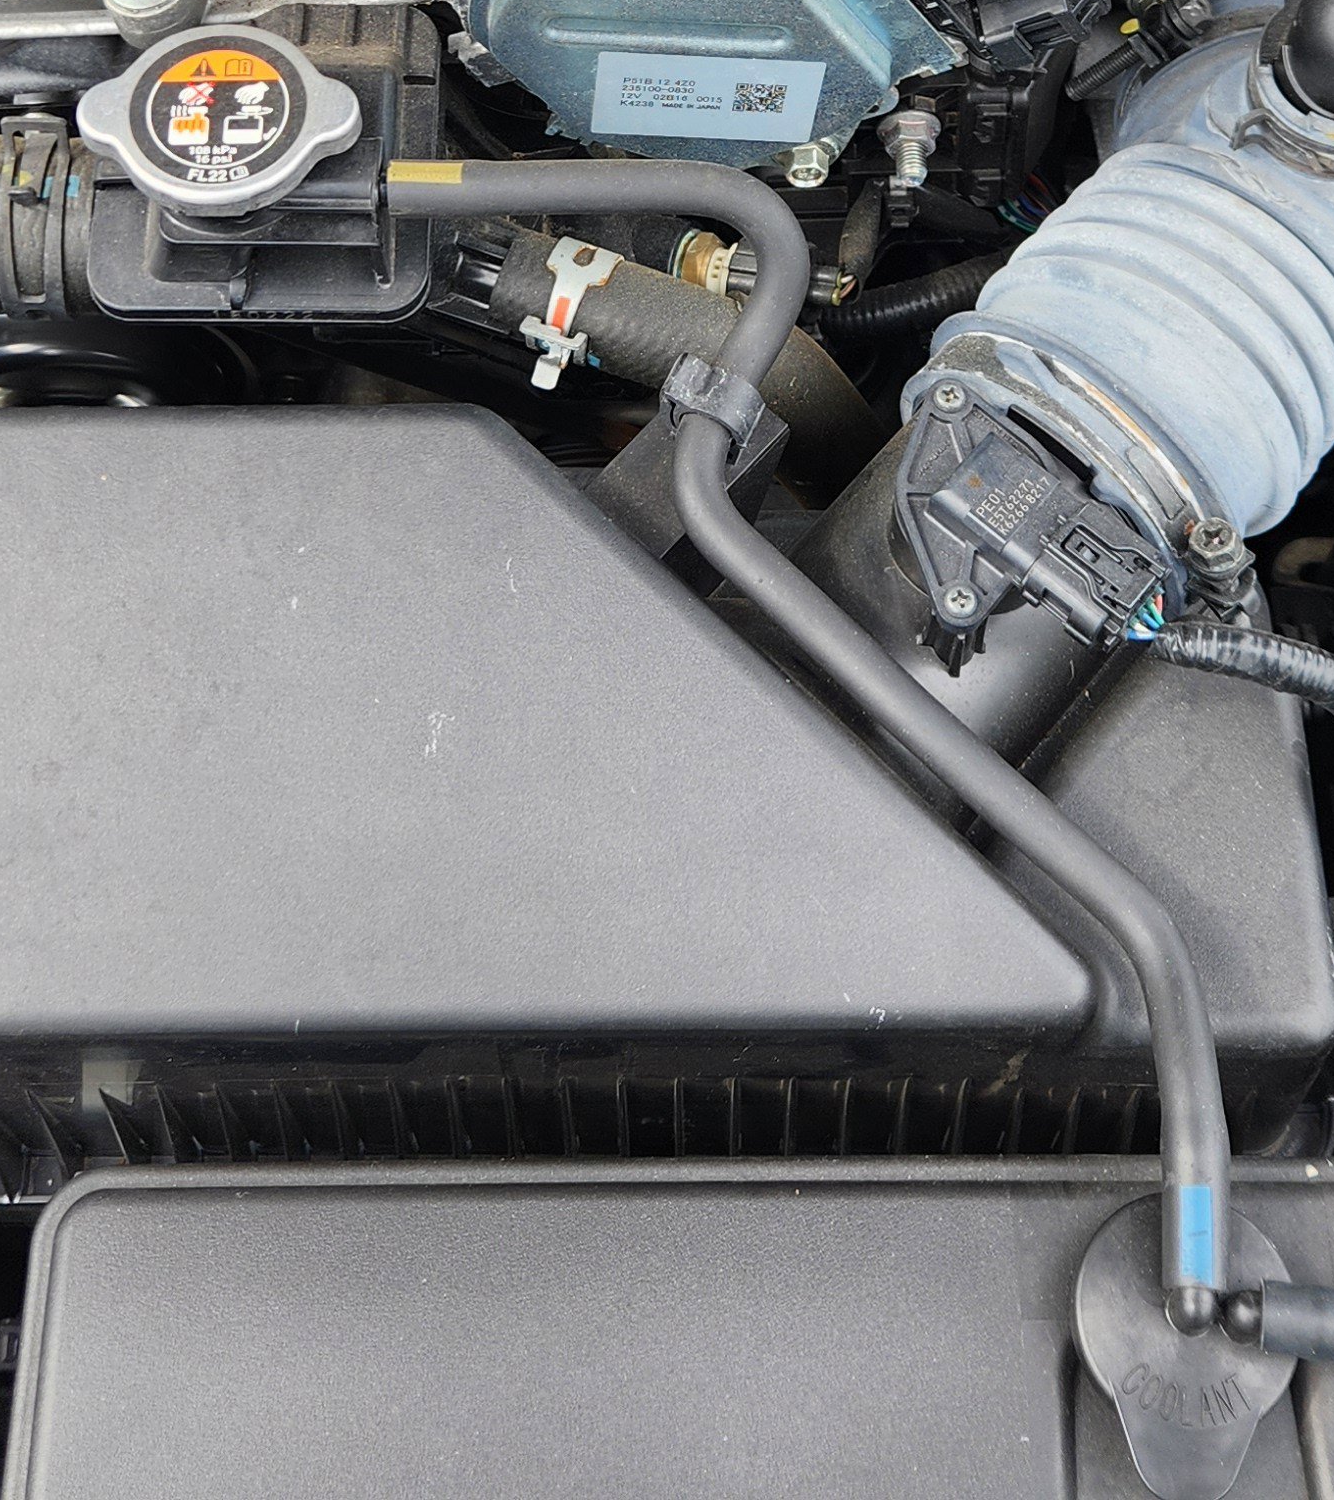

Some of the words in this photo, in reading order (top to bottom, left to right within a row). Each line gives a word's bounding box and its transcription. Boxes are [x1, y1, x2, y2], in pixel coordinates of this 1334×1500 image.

[195, 154, 210, 164] 16
[187, 167, 228, 183] FL22
[976, 487, 1007, 519] PE01
[988, 478, 1034, 528] E5T62271
[1025, 476, 1051, 504] 8217
[1121, 1363, 1252, 1427] COOLANT
